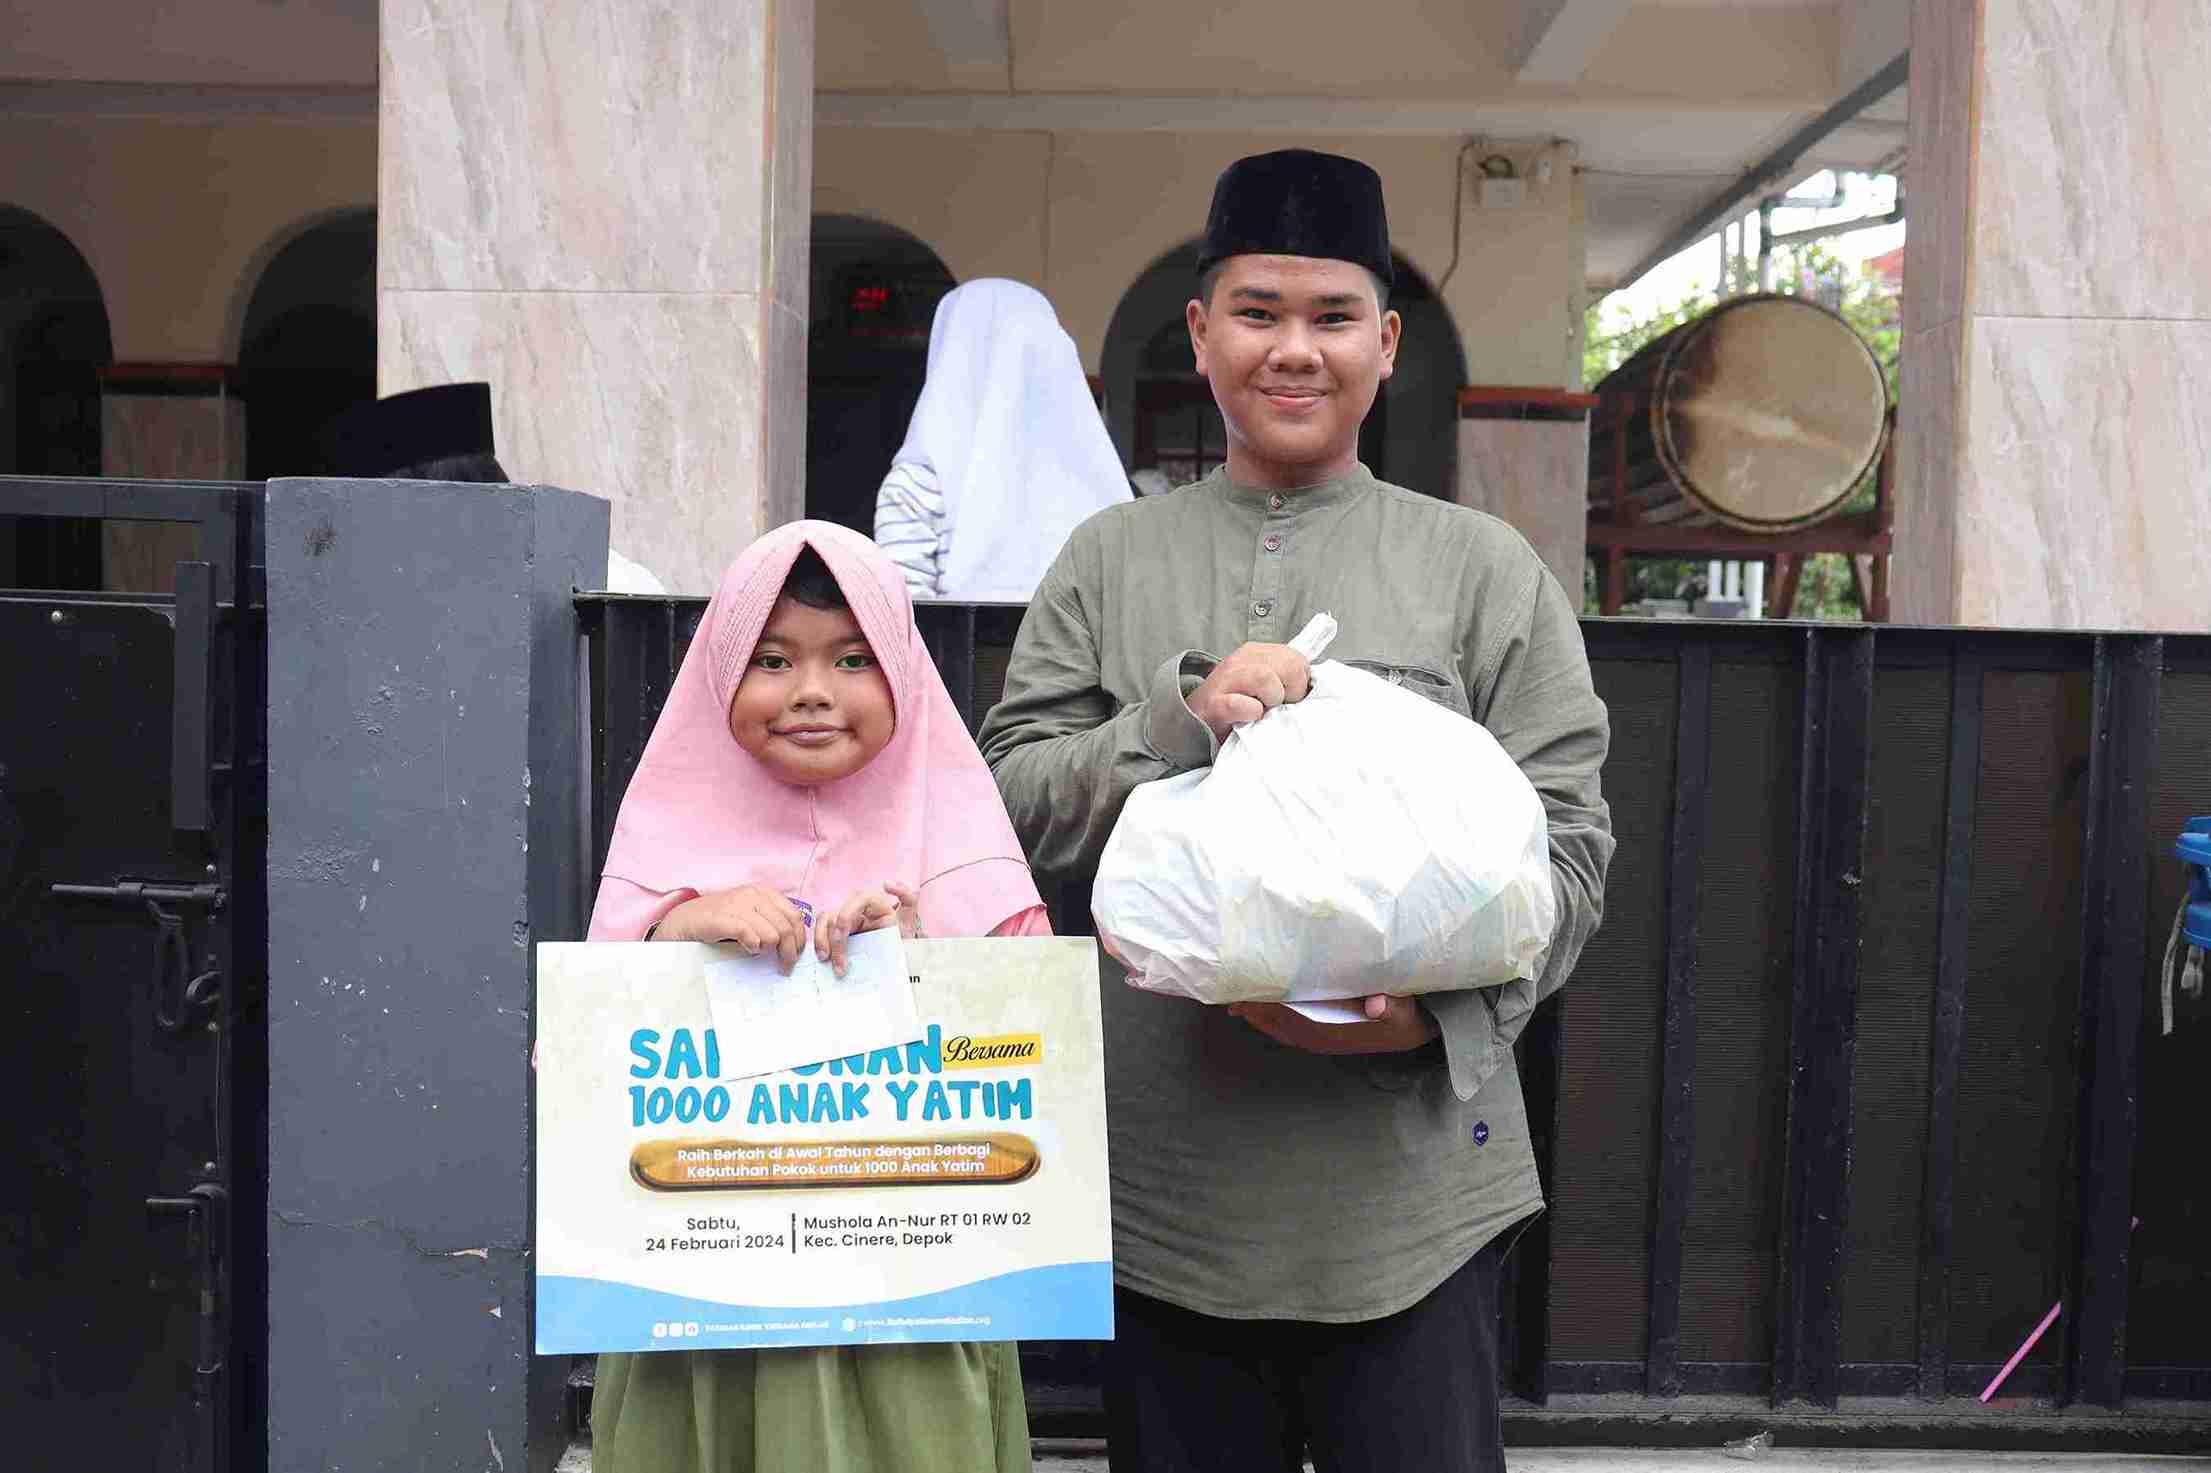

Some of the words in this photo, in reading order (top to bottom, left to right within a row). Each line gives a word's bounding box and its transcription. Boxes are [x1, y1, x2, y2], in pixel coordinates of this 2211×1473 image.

[943, 1035, 1035, 1062] Bersama
[628, 1085, 731, 1127] 1000
[747, 1082, 871, 1124] ANAK
[885, 1078, 1032, 1121] YATIM
[678, 1147, 711, 1161] Raih
[713, 1146, 765, 1161] Berkah
[768, 1146, 783, 1160] di
[786, 1146, 822, 1160] Awal
[824, 1145, 872, 1158] Tahun
[875, 1144, 930, 1159] dengan
[934, 1143, 991, 1158] Berbagi
[687, 1165, 769, 1178] Kebutuhan
[772, 1163, 817, 1177] Pokok
[819, 1162, 861, 1175] untuk
[864, 1161, 898, 1174] 1000
[900, 1160, 939, 1174] Anak
[942, 1159, 985, 1173] Yatim
[686, 1216, 740, 1231] Sabtu,
[804, 1215, 873, 1230] Mushola
[877, 1213, 936, 1228] An-Nur
[940, 1213, 959, 1226] RT
[962, 1213, 979, 1226] 01
[982, 1212, 1008, 1225] RW
[1012, 1211, 1031, 1225] 02
[645, 1237, 666, 1251] 24
[671, 1234, 740, 1250] Februari
[744, 1234, 785, 1249] 2024
[804, 1234, 838, 1248] Kec.
[842, 1232, 898, 1248] Cinere,
[902, 1231, 953, 1248] Depok
